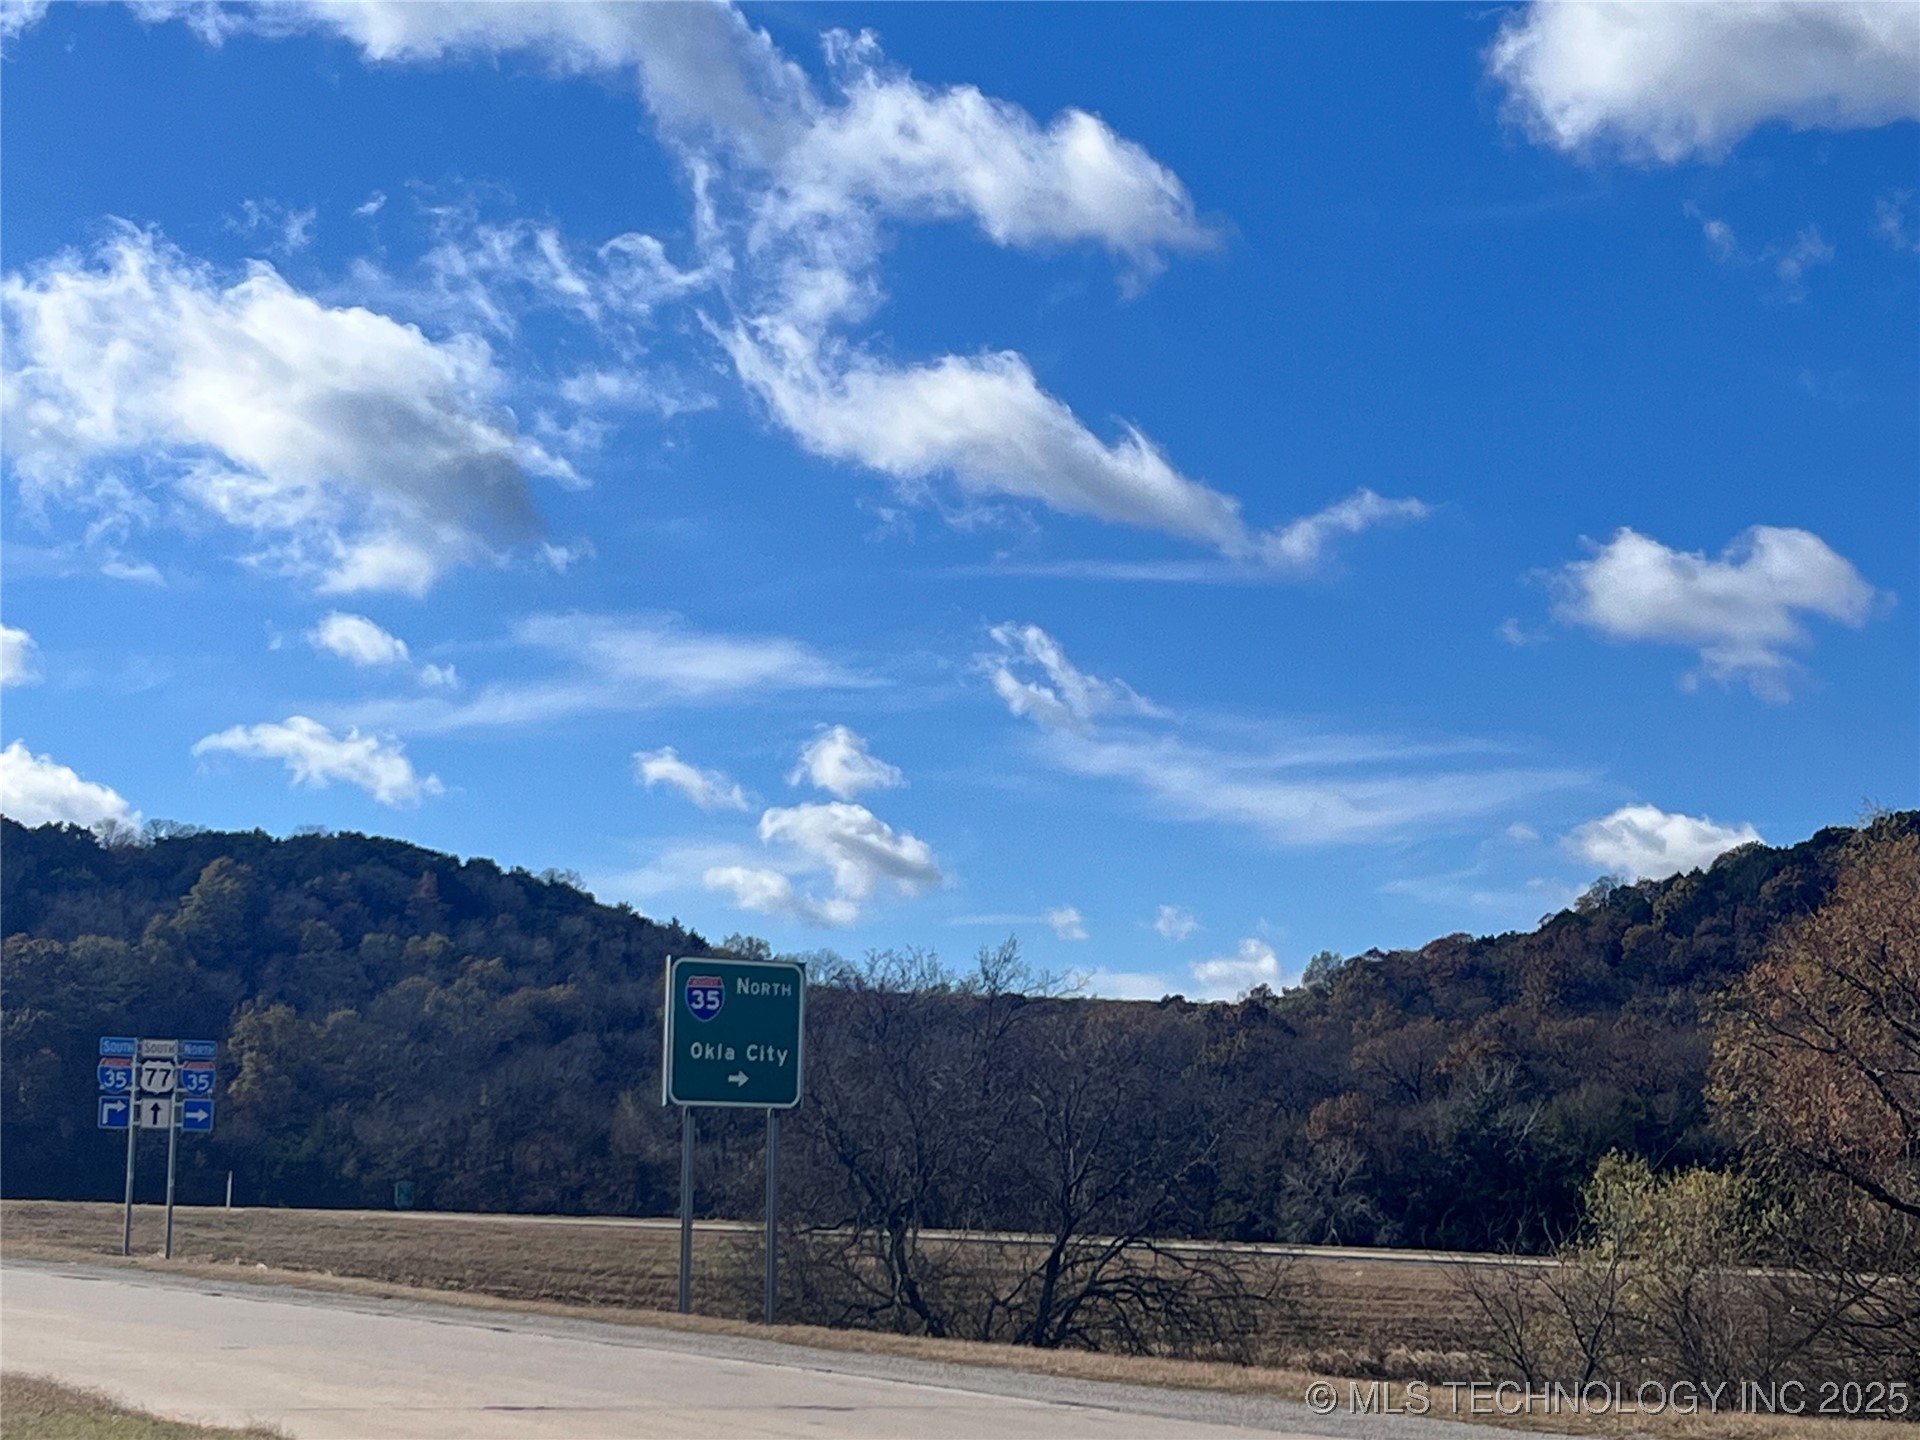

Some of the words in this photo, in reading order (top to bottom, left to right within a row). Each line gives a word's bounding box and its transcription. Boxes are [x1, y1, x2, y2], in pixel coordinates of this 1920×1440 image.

[690, 989, 721, 1010] 35
[736, 977, 792, 997] NORTH
[103, 1040, 134, 1053] SOUTH
[144, 1042, 176, 1054] SOUTH
[184, 1044, 215, 1056] NORTH
[690, 1042, 736, 1060] Okla
[746, 1044, 788, 1067] City
[104, 1069, 127, 1088] 35
[145, 1068, 172, 1087] 77
[187, 1074, 210, 1091] 35
